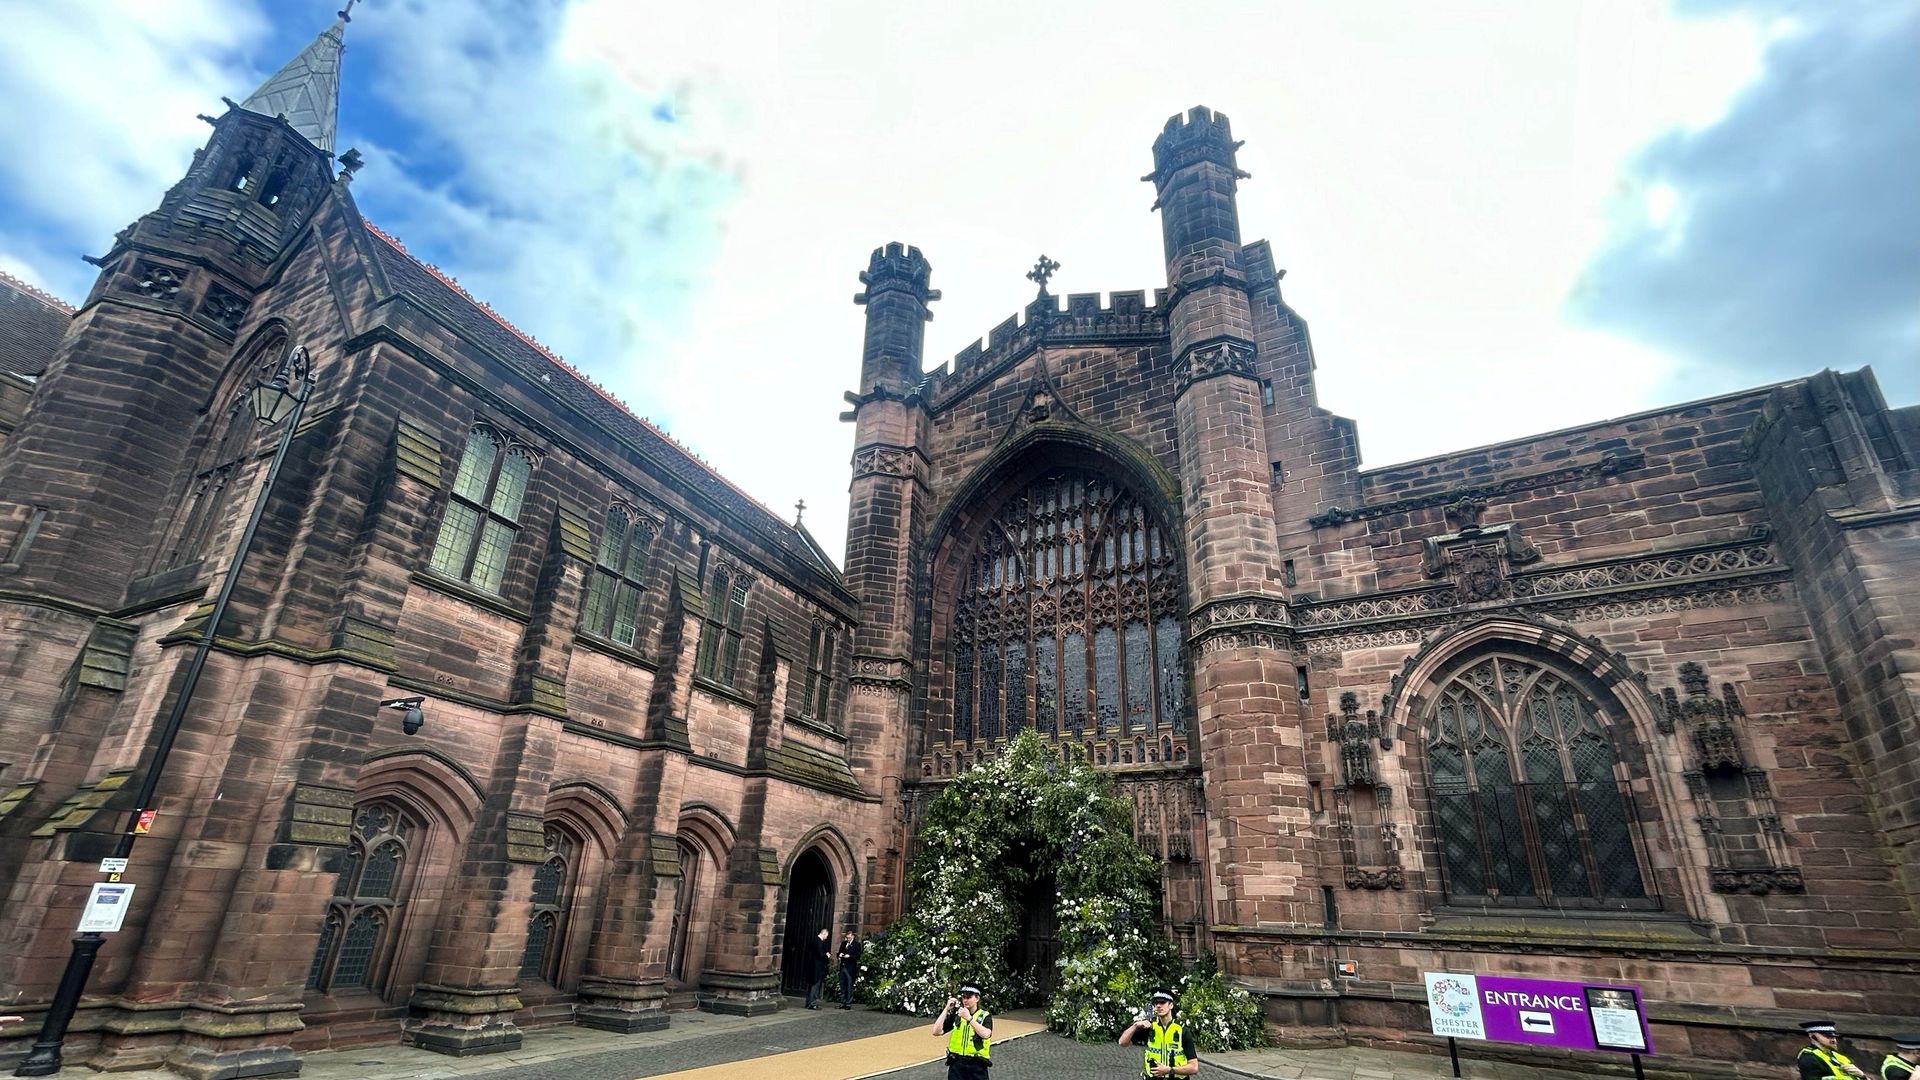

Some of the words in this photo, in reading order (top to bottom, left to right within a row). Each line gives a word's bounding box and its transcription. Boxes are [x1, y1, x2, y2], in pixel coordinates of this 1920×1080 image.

[112, 873, 119, 881] 2
[1485, 991, 1584, 1011] ENTRANCE
[1434, 1018, 1479, 1029] CHESTER
[1436, 1026, 1480, 1036] CATHEDRAL
